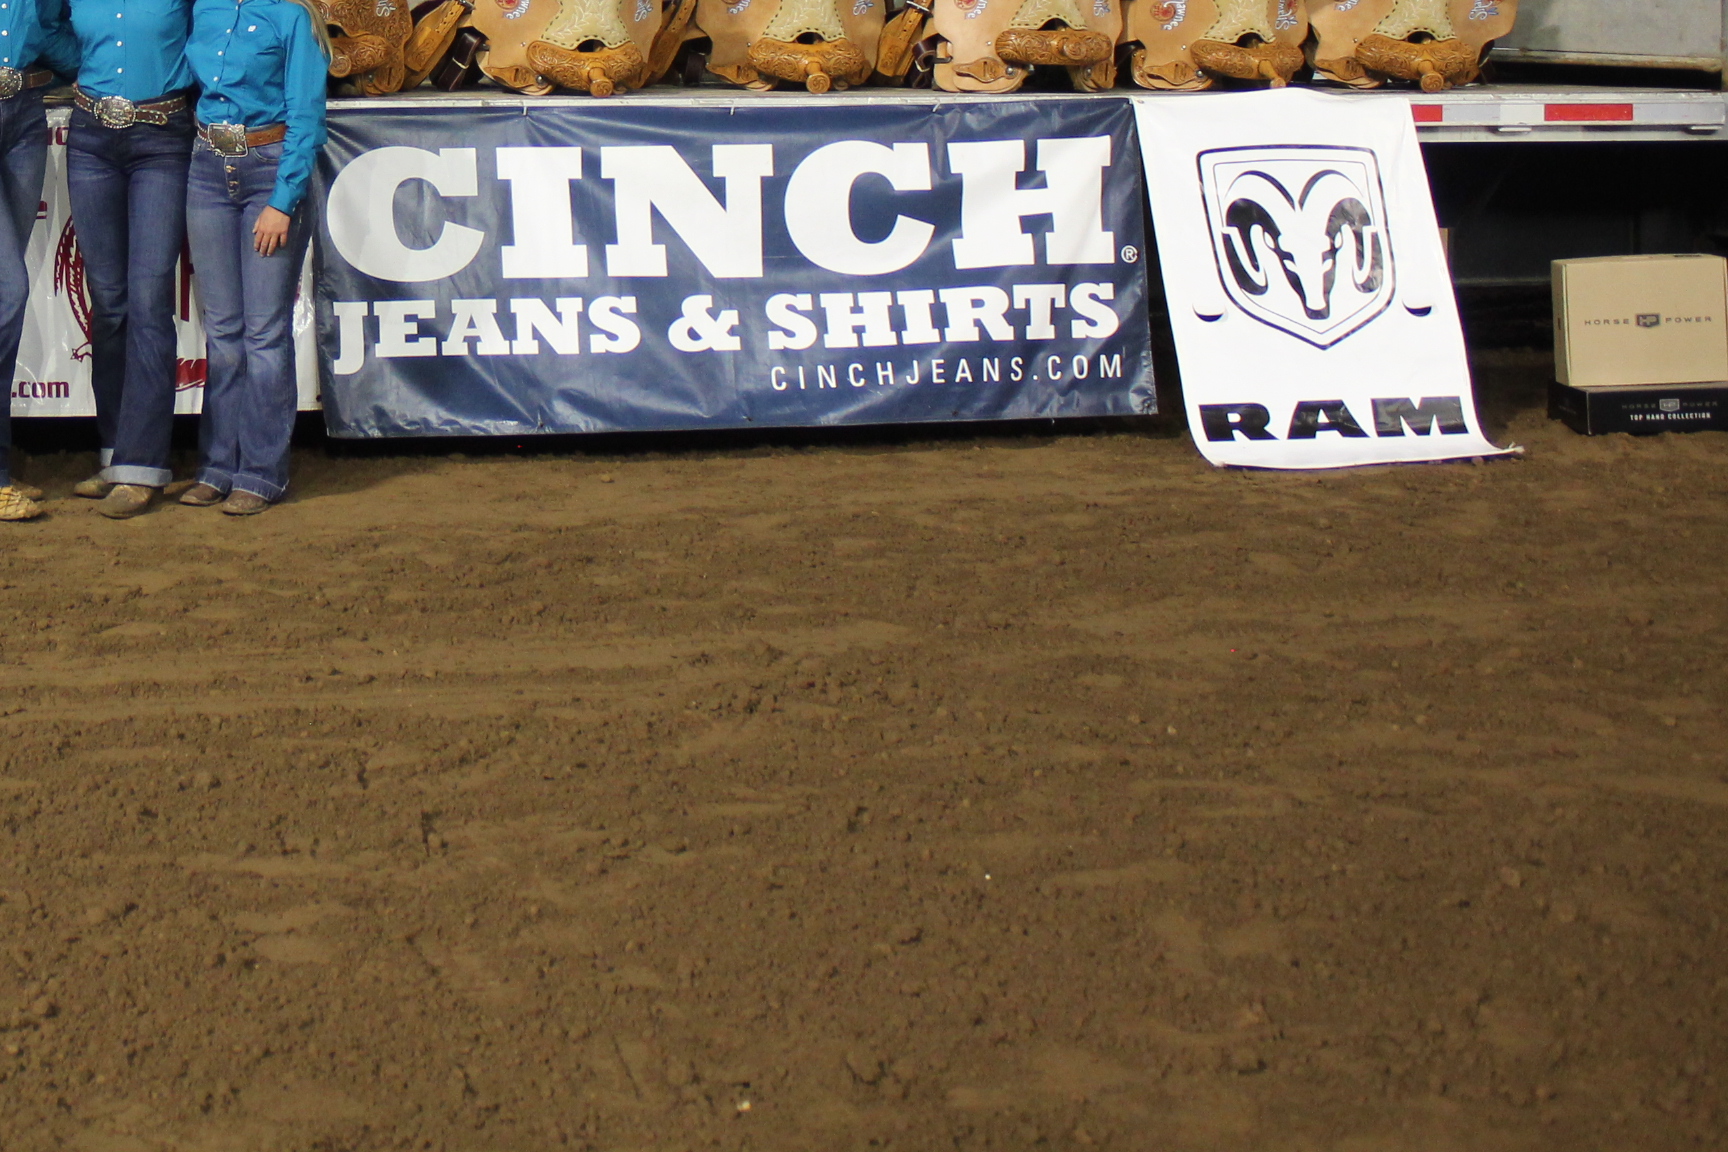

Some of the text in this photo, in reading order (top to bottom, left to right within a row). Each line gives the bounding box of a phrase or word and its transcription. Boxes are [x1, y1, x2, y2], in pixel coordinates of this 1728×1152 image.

[326, 134, 1117, 283] CINCH
[333, 282, 1120, 375] JEANS & SHIRTS
[1584, 318, 1630, 326] HORSE
[1665, 315, 1712, 324] POWER
[770, 354, 1123, 393] CINCHJEANS.COM
[1198, 396, 1470, 443] RAM
[1630, 412, 1712, 421] TOP HAND COLLECTION
